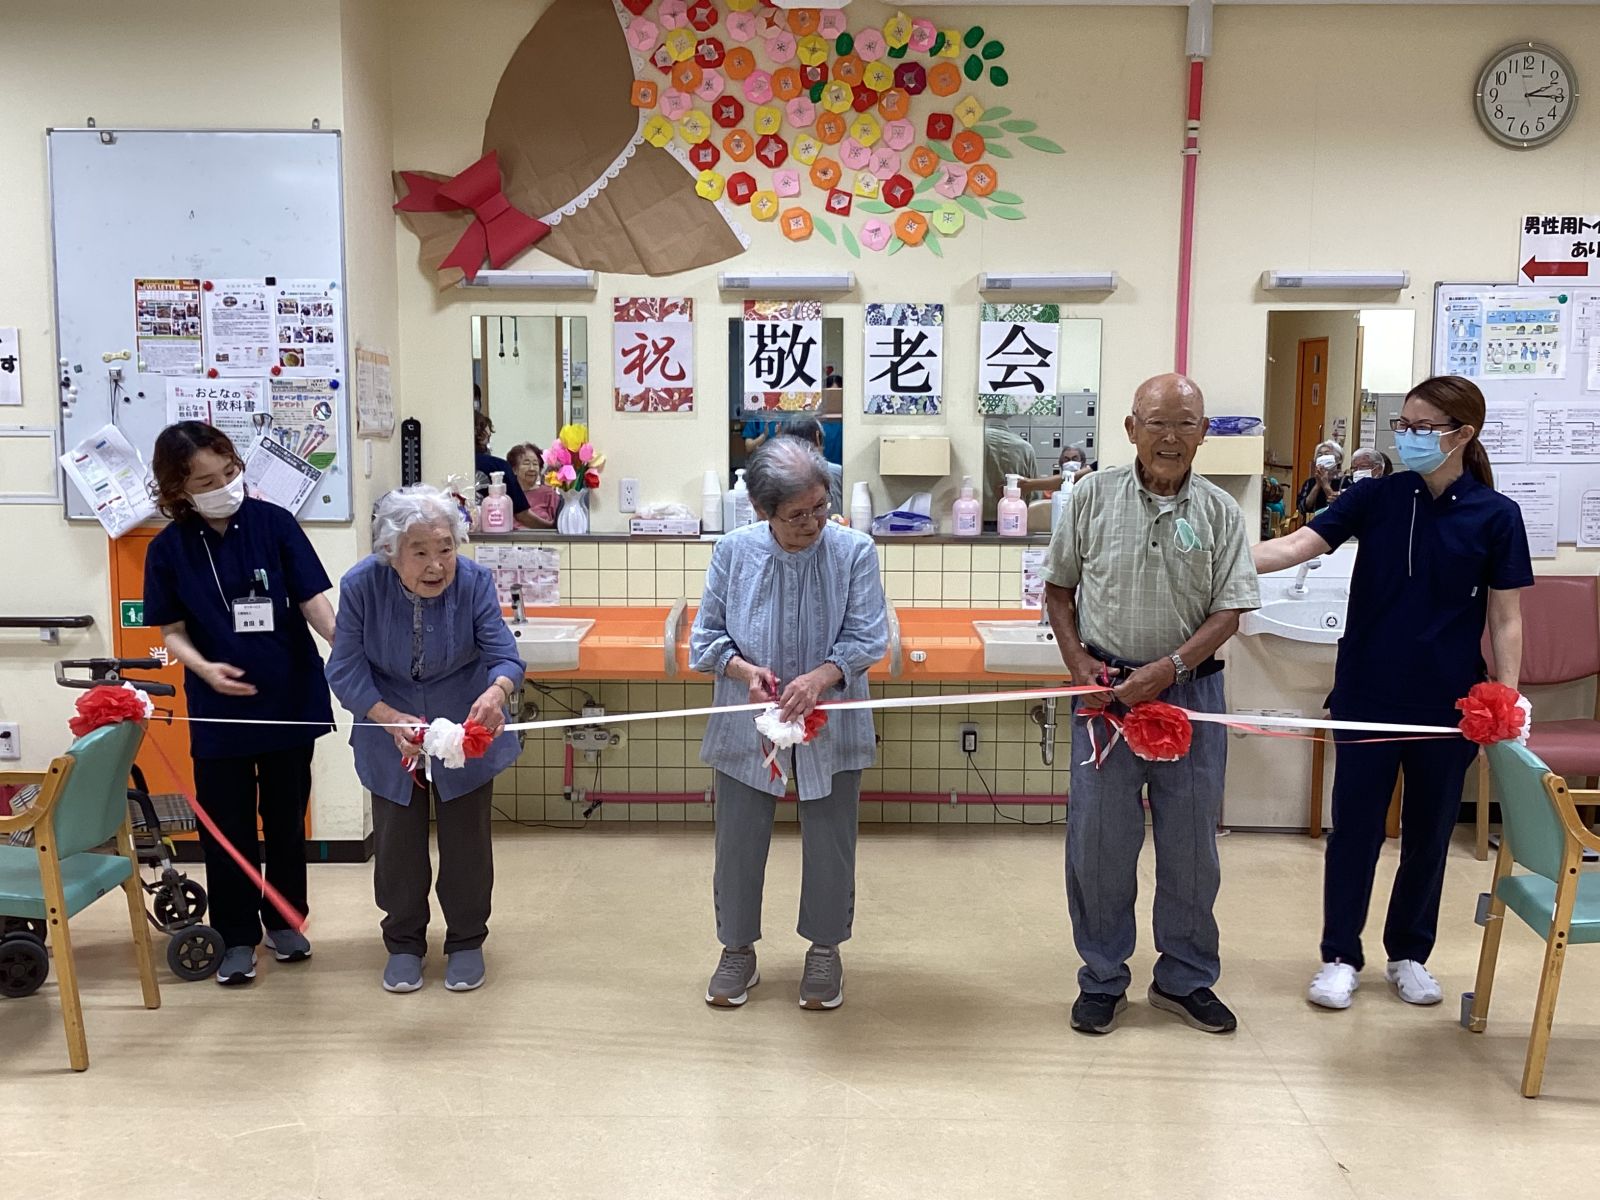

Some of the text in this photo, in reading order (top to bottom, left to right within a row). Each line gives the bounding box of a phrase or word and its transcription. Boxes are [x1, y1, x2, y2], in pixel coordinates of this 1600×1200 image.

[1509, 60, 1518, 73] 11
[1523, 55, 1535, 70] 12
[1542, 60, 1545, 74] 1
[1496, 71, 1506, 85] 10
[1550, 71, 1559, 84] 2
[1490, 88, 1498, 103] 9
[1555, 88, 1564, 103] 3
[1494, 104, 1504, 119] 8
[1548, 105, 1556, 120] 4
[1507, 117, 1515, 132] 7
[1520, 120, 1529, 135] 6
[1536, 117, 1544, 131] 5
[0, 354, 18, 374] す
[622, 331, 686, 387] 祝
[748, 323, 818, 390] 敬
[868, 328, 938, 394] 老
[985, 323, 1053, 394] 会
[196, 388, 241, 398] おとなの
[216, 400, 256, 412] 教科書
